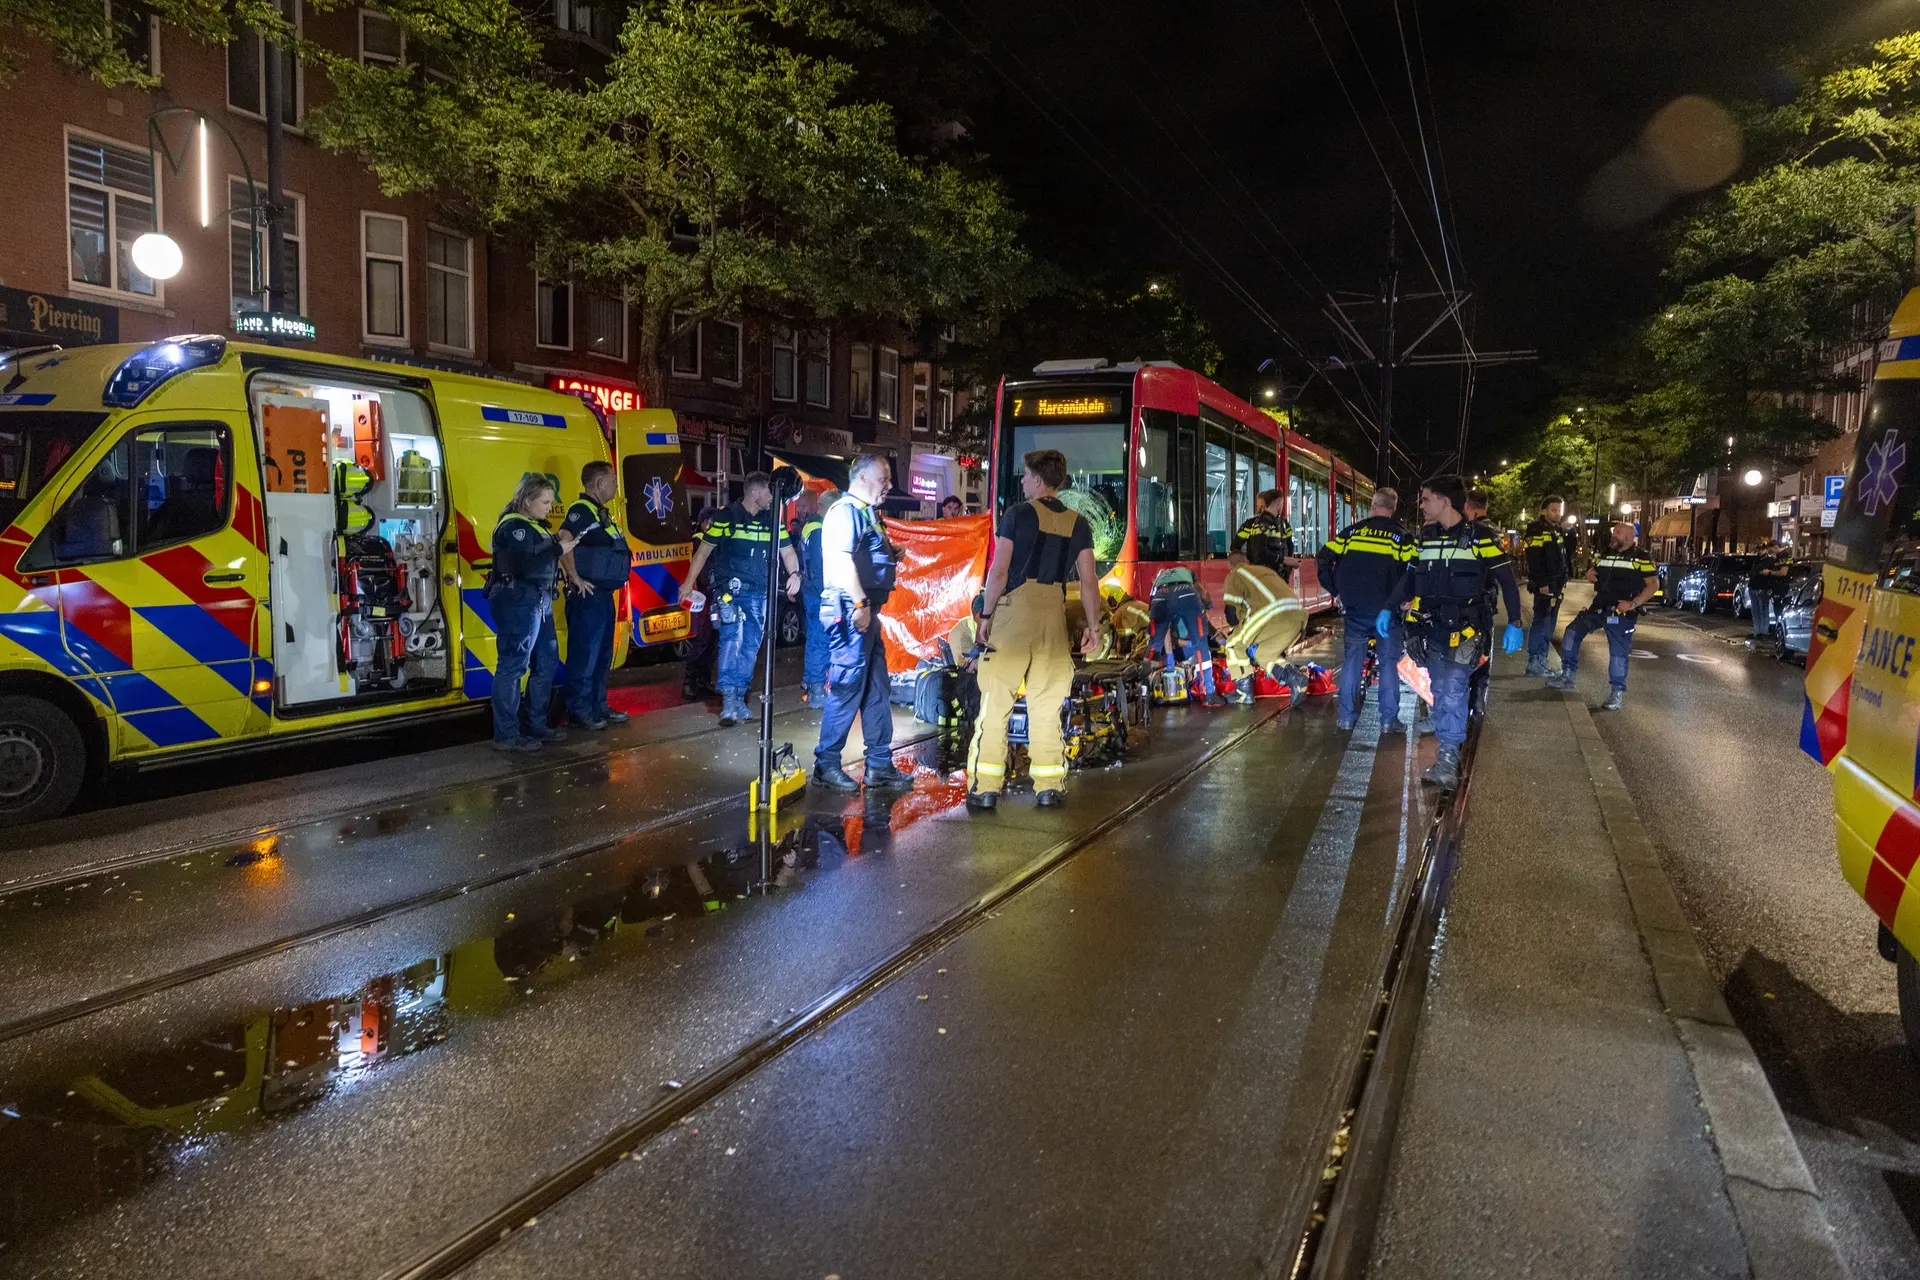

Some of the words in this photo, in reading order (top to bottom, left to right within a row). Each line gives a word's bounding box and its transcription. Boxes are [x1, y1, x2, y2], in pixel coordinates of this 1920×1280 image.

[27, 295, 102, 343] Piercing
[1014, 399, 1022, 416] 7
[1039, 398, 1104, 415] Marconiplein
[513, 412, 539, 423] 17-109
[1830, 478, 1845, 496] P
[631, 546, 690, 563] AMBULANCE
[1837, 576, 1873, 603] 17-111
